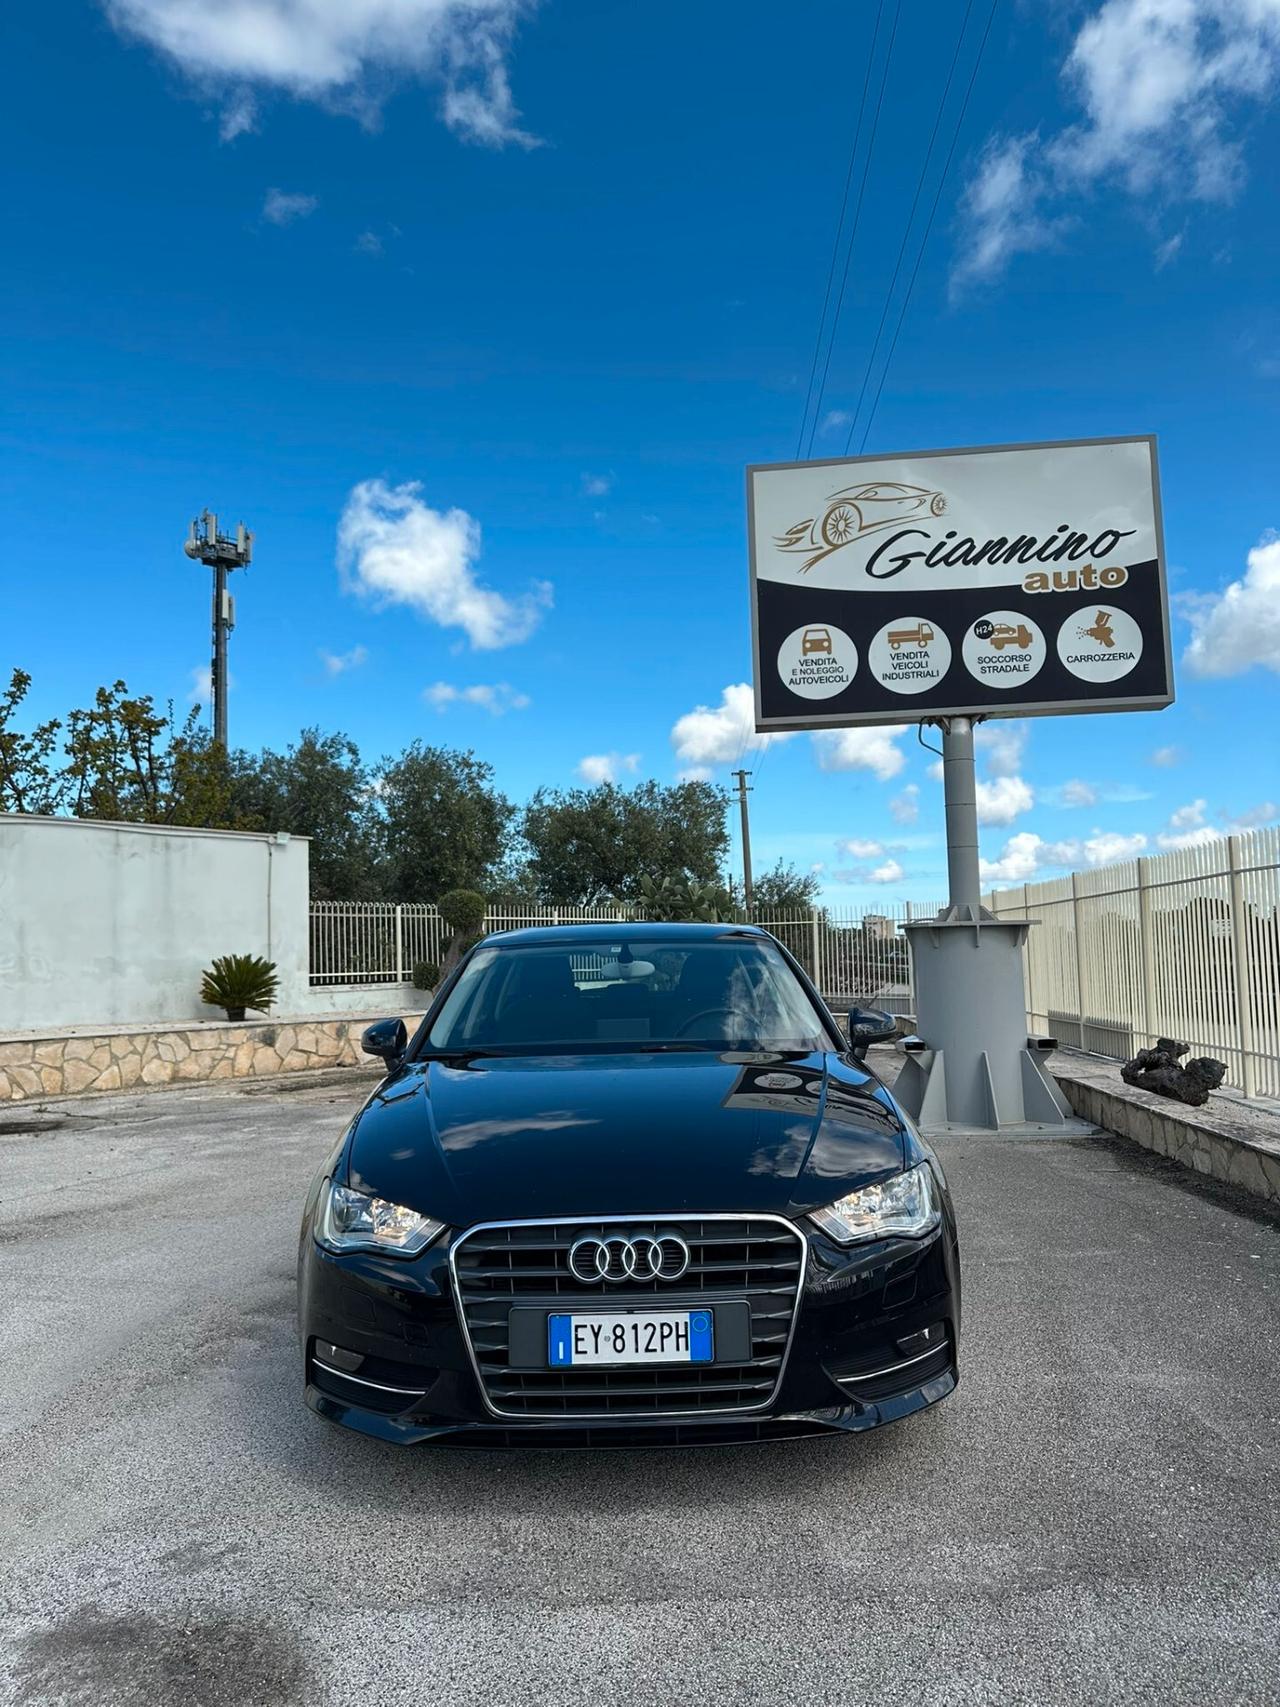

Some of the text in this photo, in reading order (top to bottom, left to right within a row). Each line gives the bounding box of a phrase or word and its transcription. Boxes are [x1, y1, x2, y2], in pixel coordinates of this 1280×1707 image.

[866, 524, 1136, 579] Giannino
[1022, 564, 1128, 593] auto
[975, 624, 993, 636] H24
[890, 651, 929, 661] VENDITA
[978, 654, 1032, 664] SOCCORSO
[1067, 652, 1135, 663] CARROZZERIA
[799, 658, 837, 667] VENDITA
[892, 661, 928, 671] VEICOLI
[799, 666, 844, 675] NOLEGGIO
[980, 664, 1029, 674] STRADALE
[789, 674, 849, 686] AUTOVEICOLI
[882, 670, 939, 681] INDUSTRIALI
[574, 1321, 689, 1354] EY 812PH
